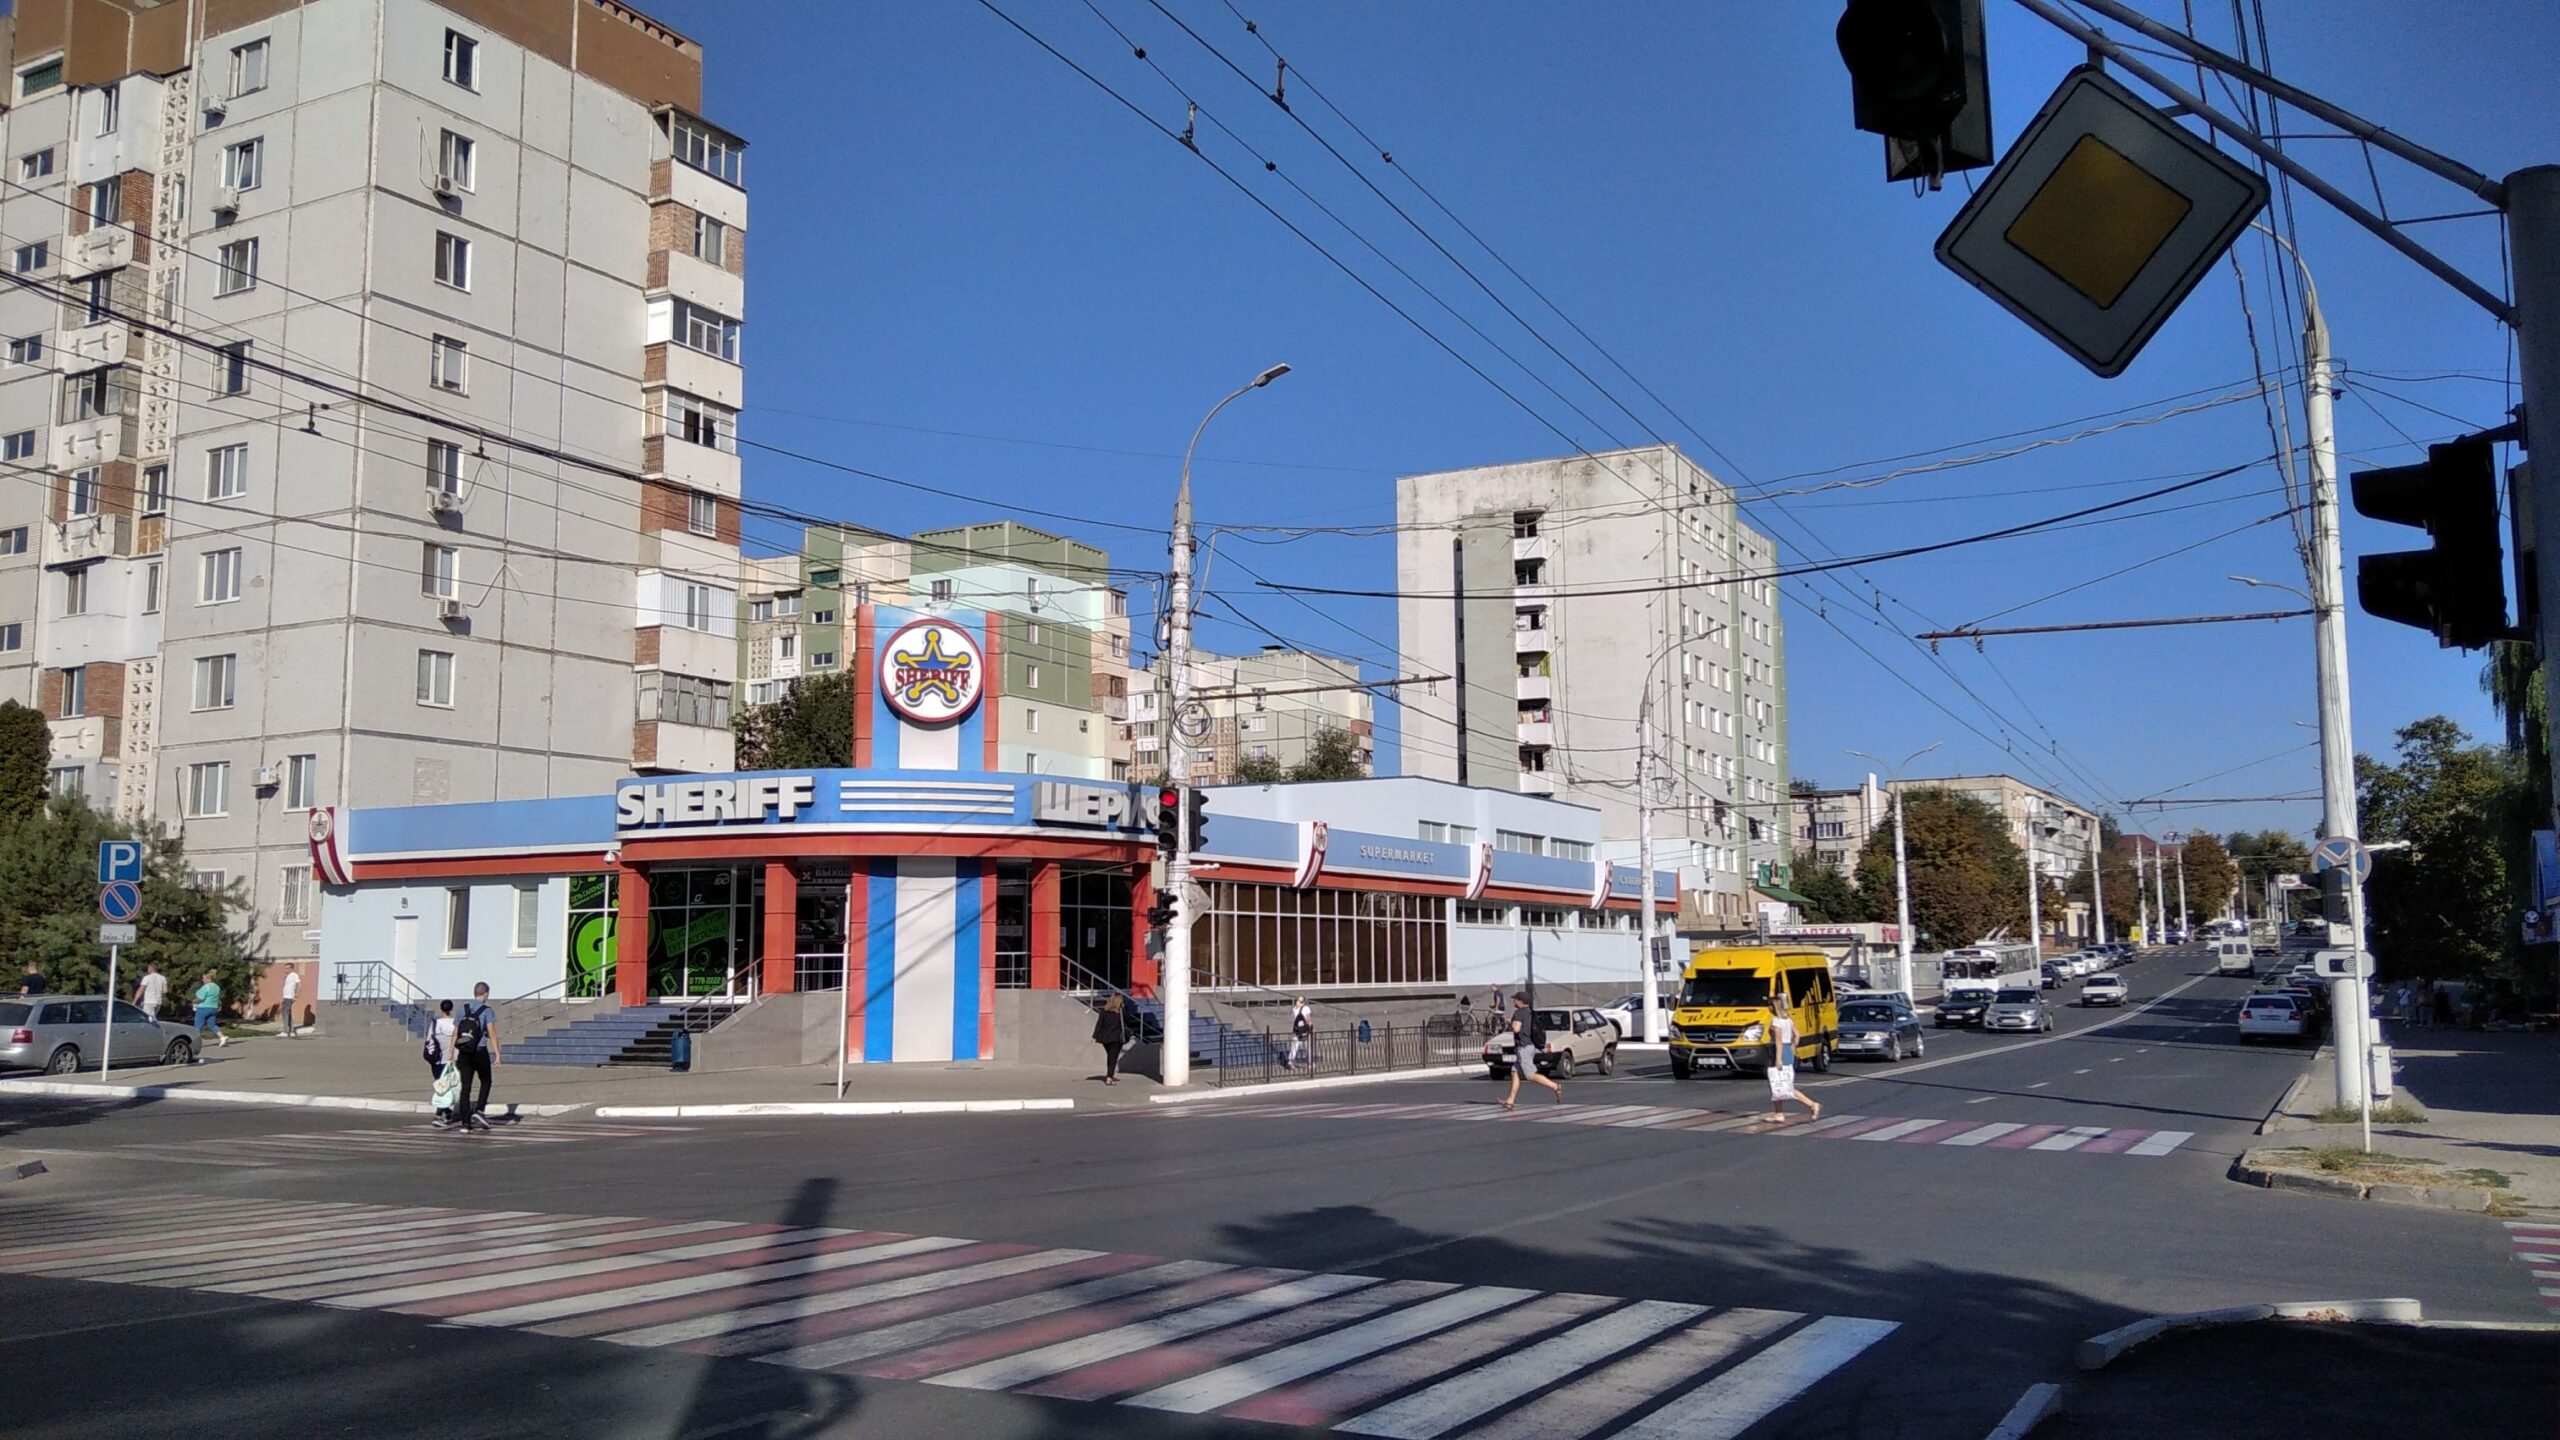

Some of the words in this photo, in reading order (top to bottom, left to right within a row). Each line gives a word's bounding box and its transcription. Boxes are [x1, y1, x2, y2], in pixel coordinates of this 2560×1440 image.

[895, 667, 971, 692] SHERIFF
[616, 776, 815, 828] SHERIFF
[109, 844, 136, 881] P
[1360, 844, 1435, 865] SUPERMARKET
[1801, 928, 1853, 937] АПТЕКА
